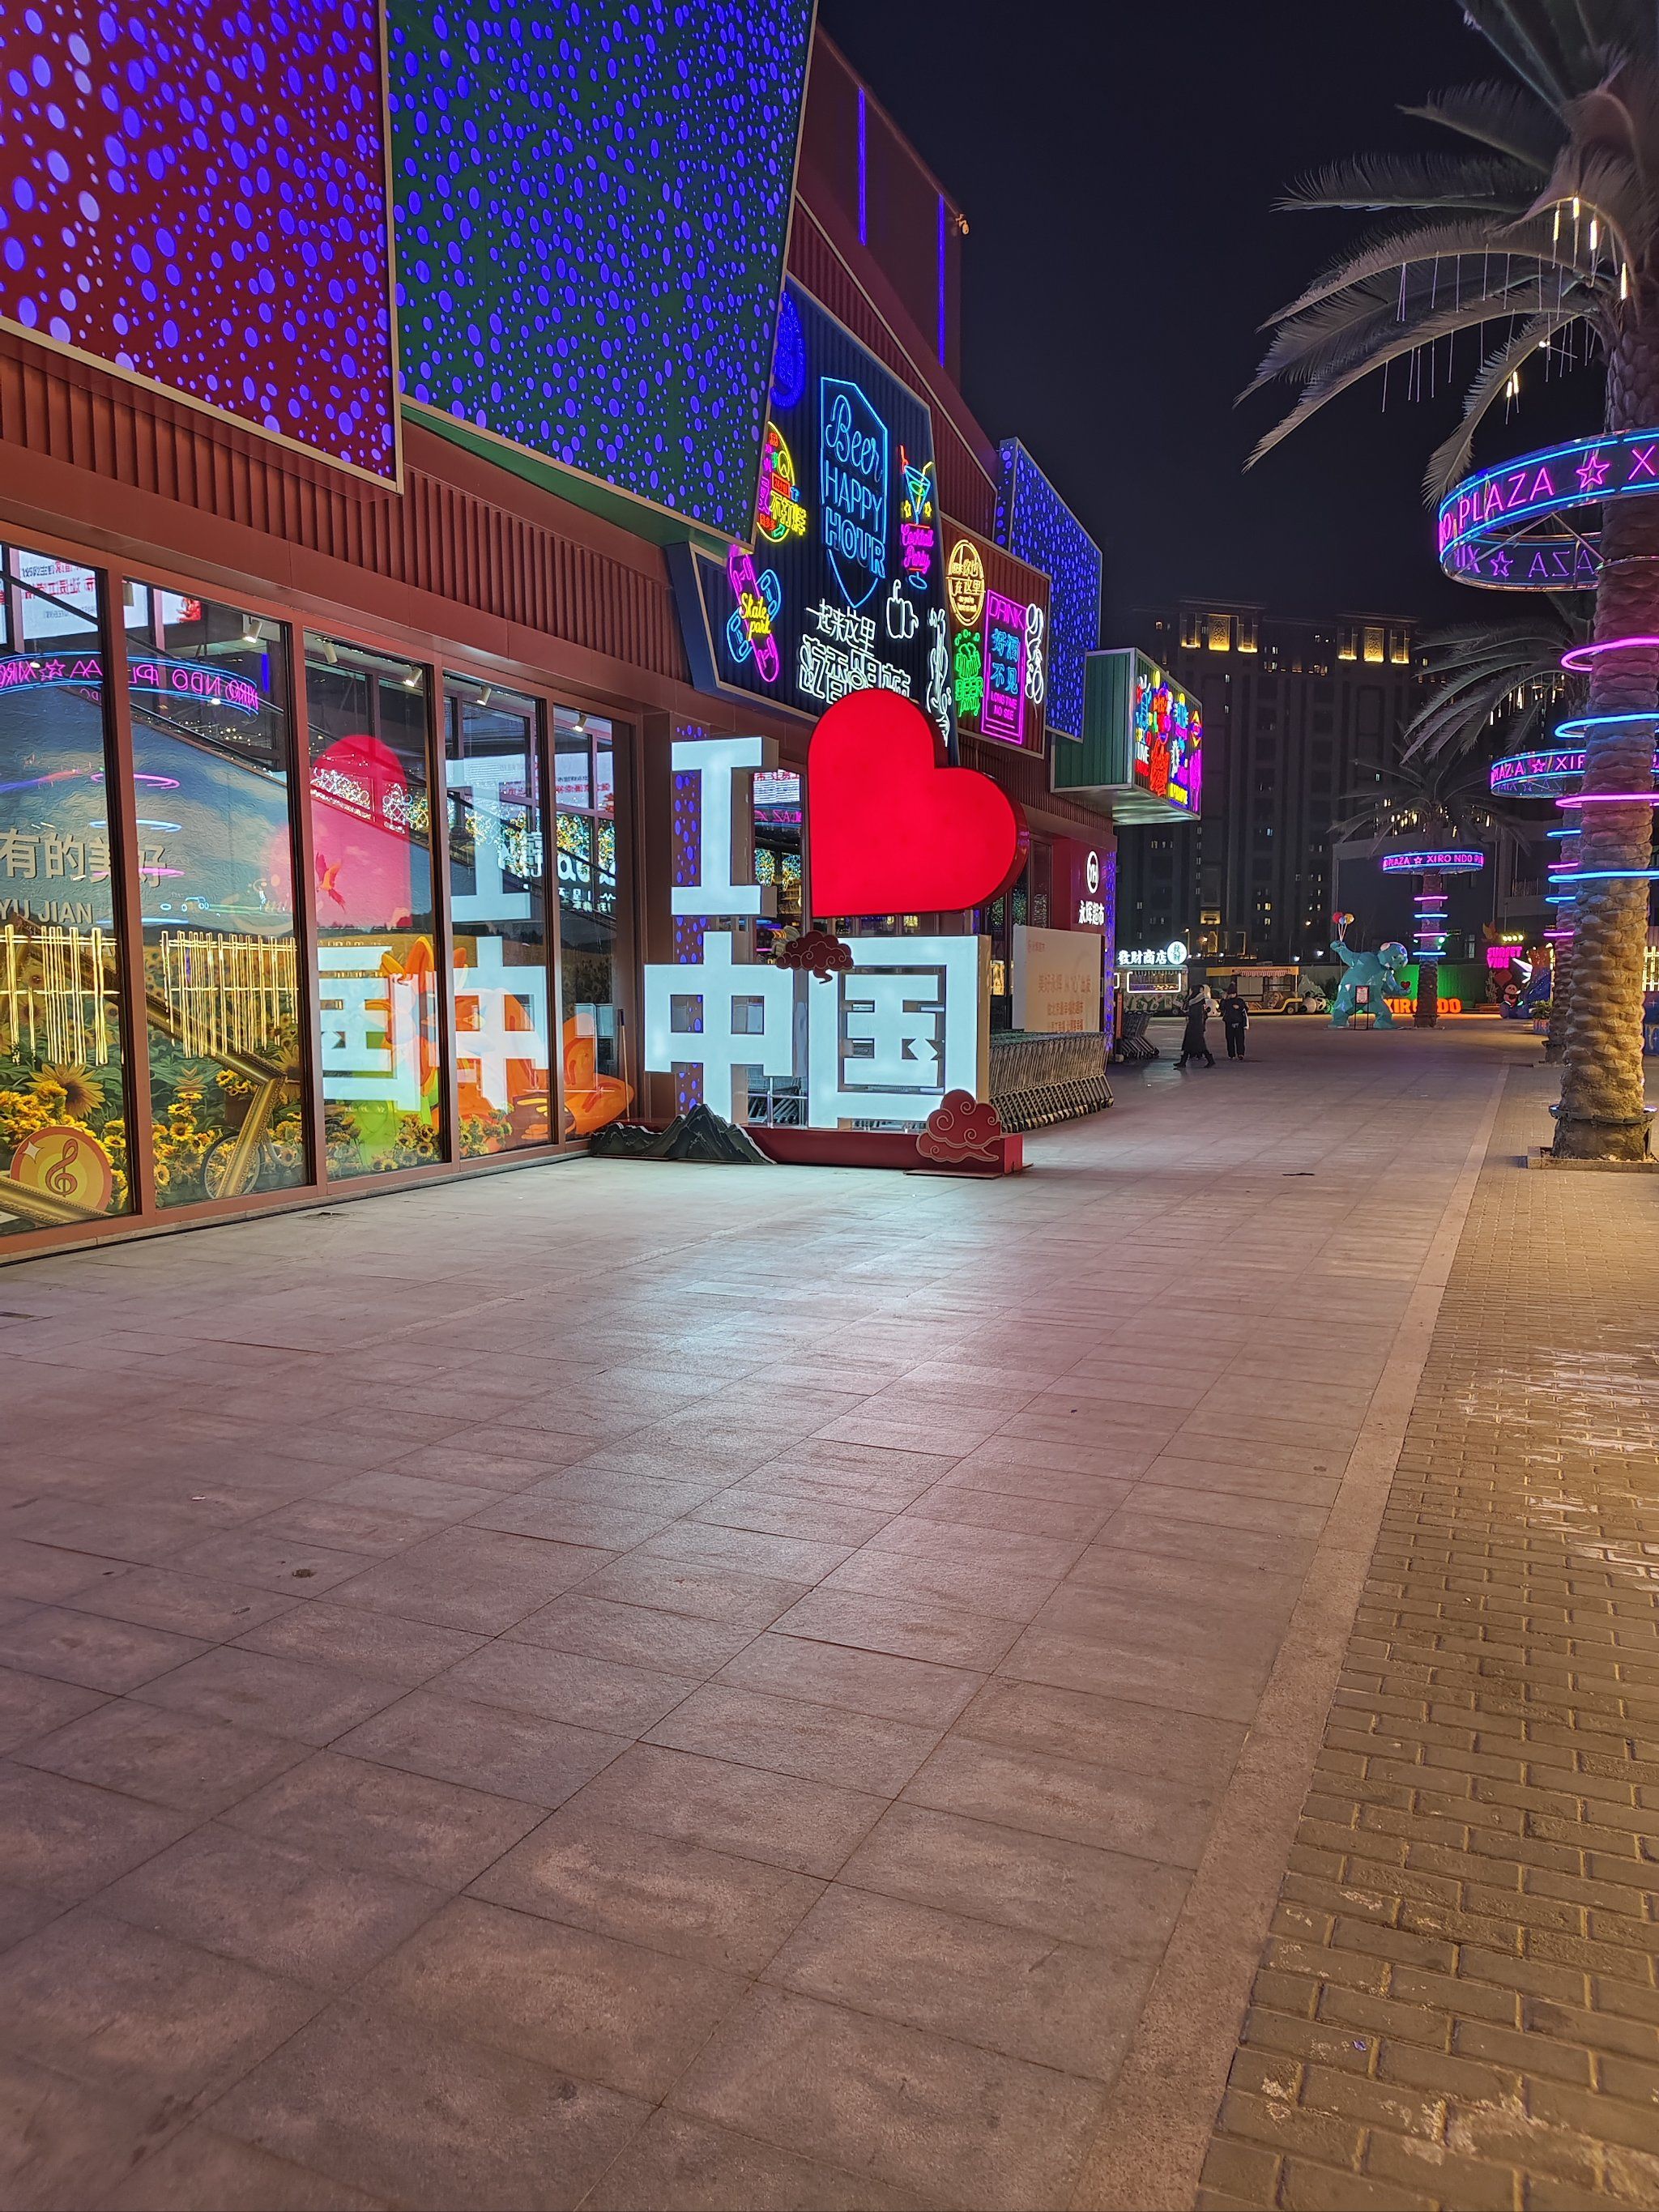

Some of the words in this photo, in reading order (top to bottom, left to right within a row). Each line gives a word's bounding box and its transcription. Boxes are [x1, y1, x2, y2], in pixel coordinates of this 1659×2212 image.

[825, 394, 883, 483] Beer
[825, 459, 882, 533] HAPPY
[1459, 467, 1555, 529] PLAZA
[770, 489, 807, 536] 不打烊
[825, 505, 886, 579] HOUR
[903, 545, 931, 574] Party
[946, 576, 986, 597] 在这里
[739, 592, 769, 620] Skate
[988, 596, 1025, 630] DRINK
[747, 613, 771, 641] park
[991, 628, 1021, 663] 好酒
[955, 676, 984, 701] BEER
[990, 662, 1018, 695] 不见
[958, 696, 981, 718] party
[991, 690, 1005, 705] LONG
[1004, 694, 1017, 710] TIME
[994, 705, 1003, 717] NO
[1004, 709, 1014, 721] SEE
[39, 900, 93, 924] JIAN
[1078, 900, 1105, 926] 永辉超市
[1117, 949, 1168, 965] 發財商店
[1487, 946, 1522, 957] SUNSET
[1487, 957, 1509, 969] VIBE
[1383, 998, 1461, 1013] XIRDO
[645, 931, 979, 1129] 中国
